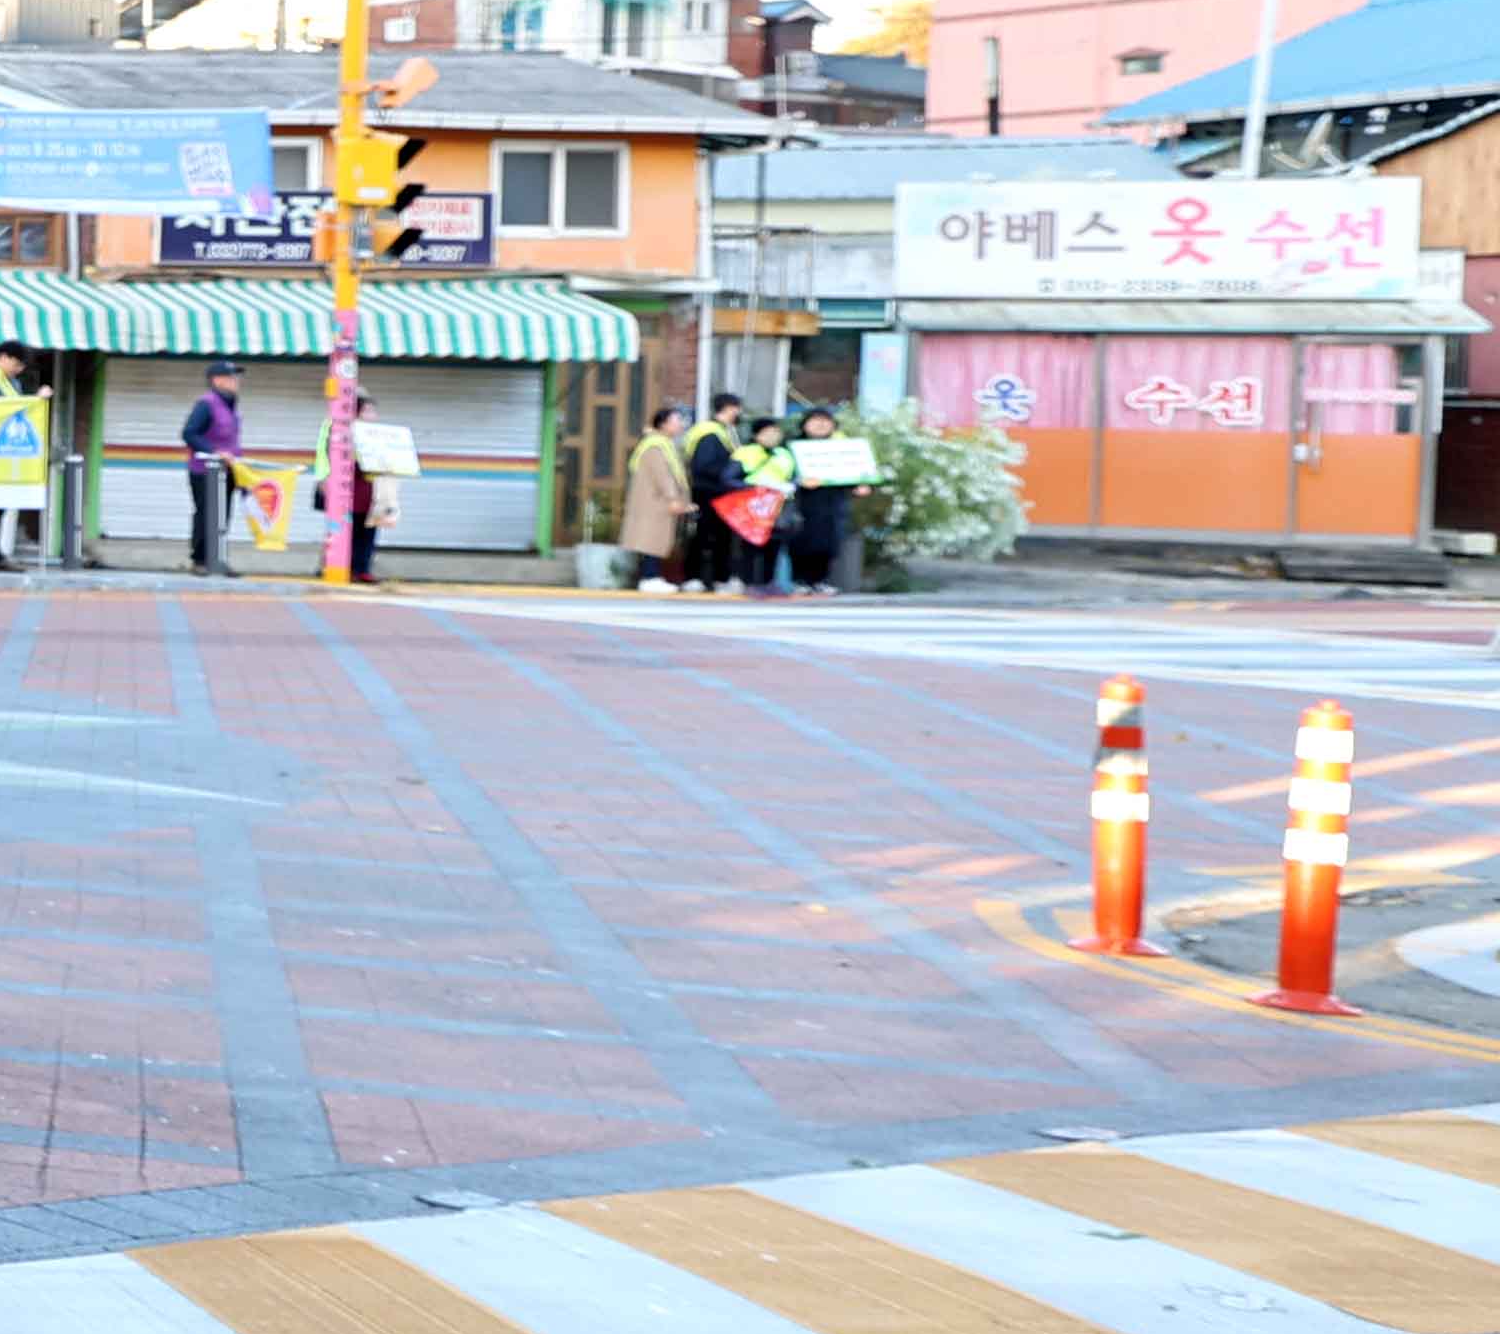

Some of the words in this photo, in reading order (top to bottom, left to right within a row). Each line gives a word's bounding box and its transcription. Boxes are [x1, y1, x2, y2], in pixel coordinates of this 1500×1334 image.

[938, 209, 1126, 261] 야베스
[1150, 196, 1224, 266] 옷
[1246, 206, 1386, 269] 수선
[1130, 378, 1260, 424] 수선
